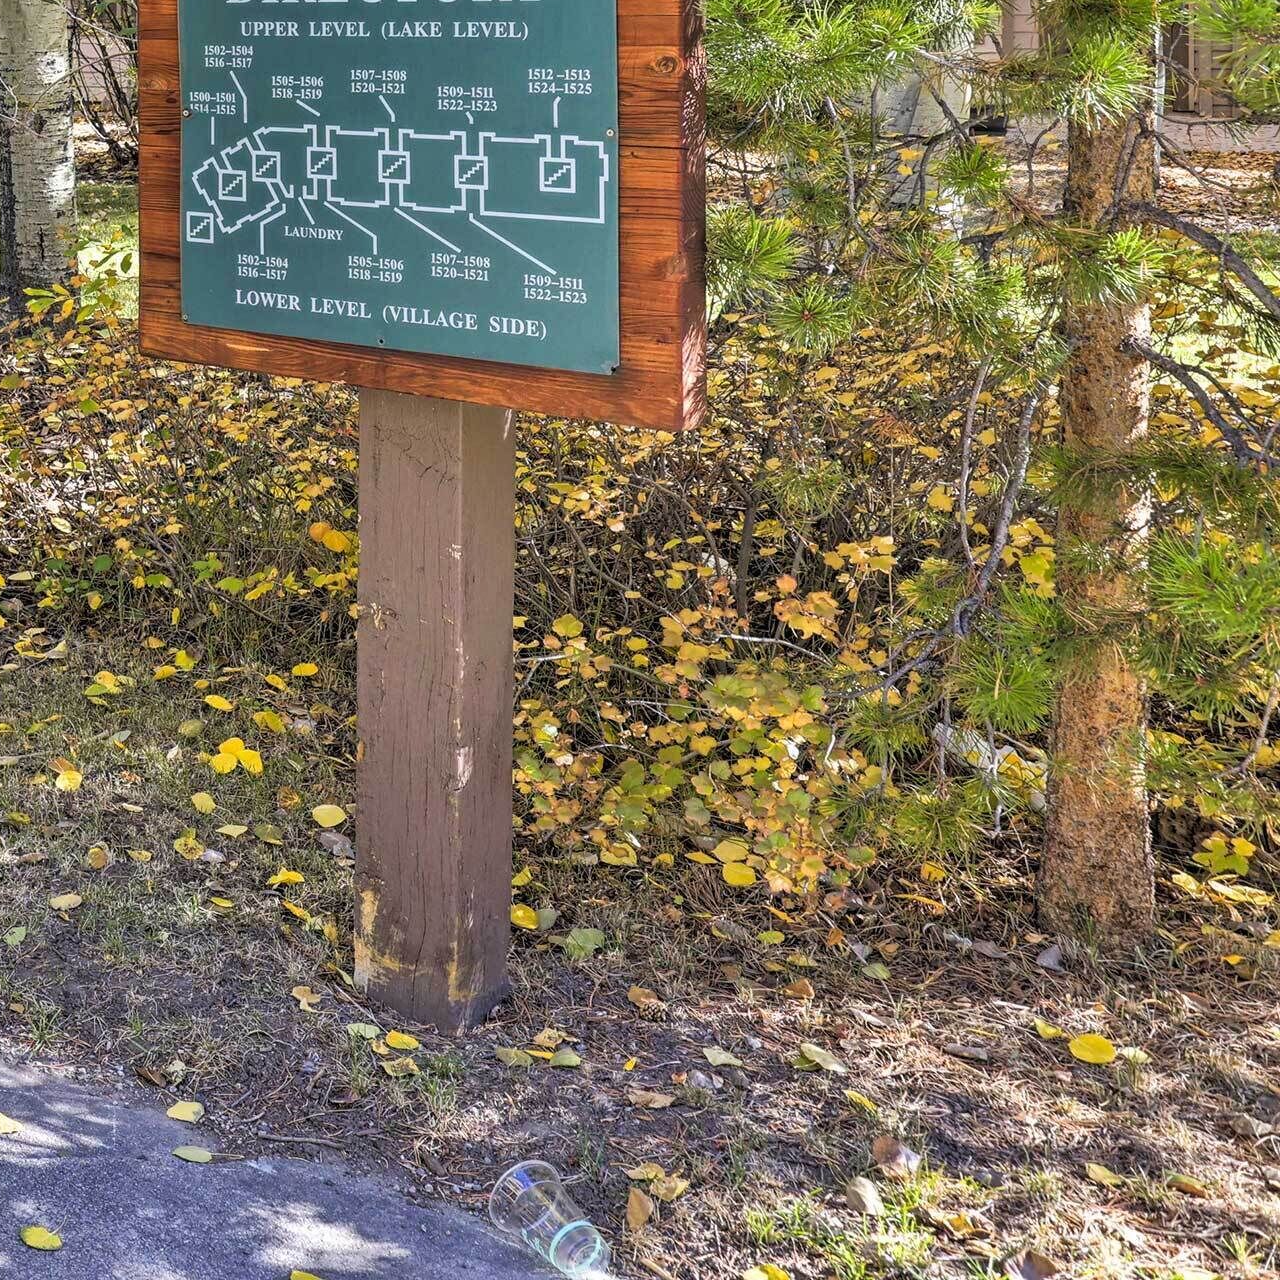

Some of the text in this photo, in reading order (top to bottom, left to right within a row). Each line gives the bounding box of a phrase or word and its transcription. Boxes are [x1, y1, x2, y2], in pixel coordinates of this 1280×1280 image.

[240, 22, 528, 41] UPPER LEVEL (LAKE LEVEL)
[205, 46, 253, 55] 1502-1504
[272, 76, 323, 86] 1505-1506
[351, 70, 406, 81] 1507-1508
[352, 83, 404, 93] 1520-1521
[438, 87, 493, 98] 1509-1511
[529, 82, 591, 94] 1524-1525
[190, 92, 235, 102] 1500-1501
[438, 100, 497, 111] 1522-1523
[285, 226, 343, 240] LAUNDRY
[238, 254, 288, 268] 1502-1504
[349, 256, 403, 271] 1505-1506
[432, 253, 490, 268] 1507-1508
[432, 266, 490, 281] 1520-1521
[524, 274, 583, 290] 1509-1511
[525, 288, 587, 304] 1522-1523
[236, 290, 546, 340] LOWER LEVEL (VILLAGE SIDE)
